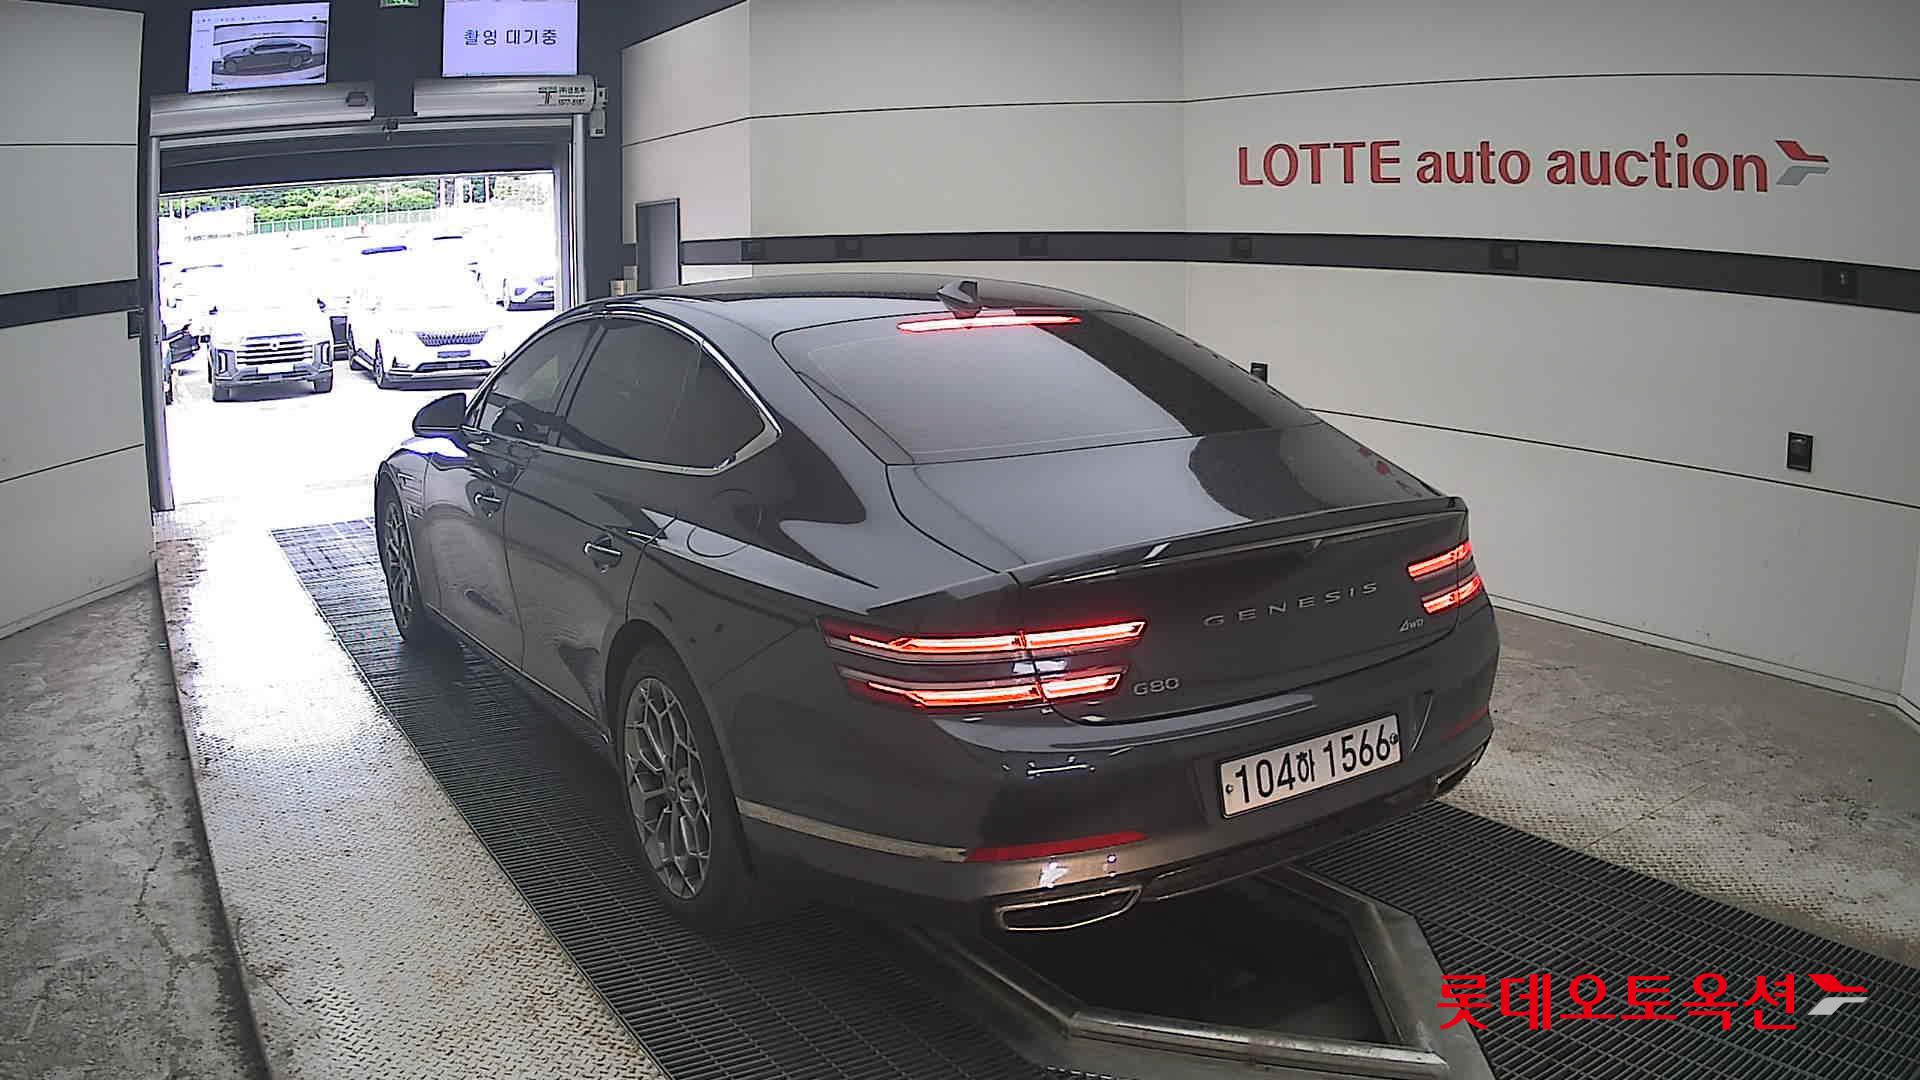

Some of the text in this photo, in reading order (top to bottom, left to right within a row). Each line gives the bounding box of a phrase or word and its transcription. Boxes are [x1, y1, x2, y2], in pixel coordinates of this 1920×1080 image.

[464, 29, 557, 46] 촬영 대기중
[1238, 134, 1768, 193] LOTTE auto auction
[1203, 581, 1378, 627] GENESIS
[1399, 617, 1425, 633] 4WD
[1133, 677, 1181, 697] G80
[1235, 724, 1391, 803] 104하 1566
